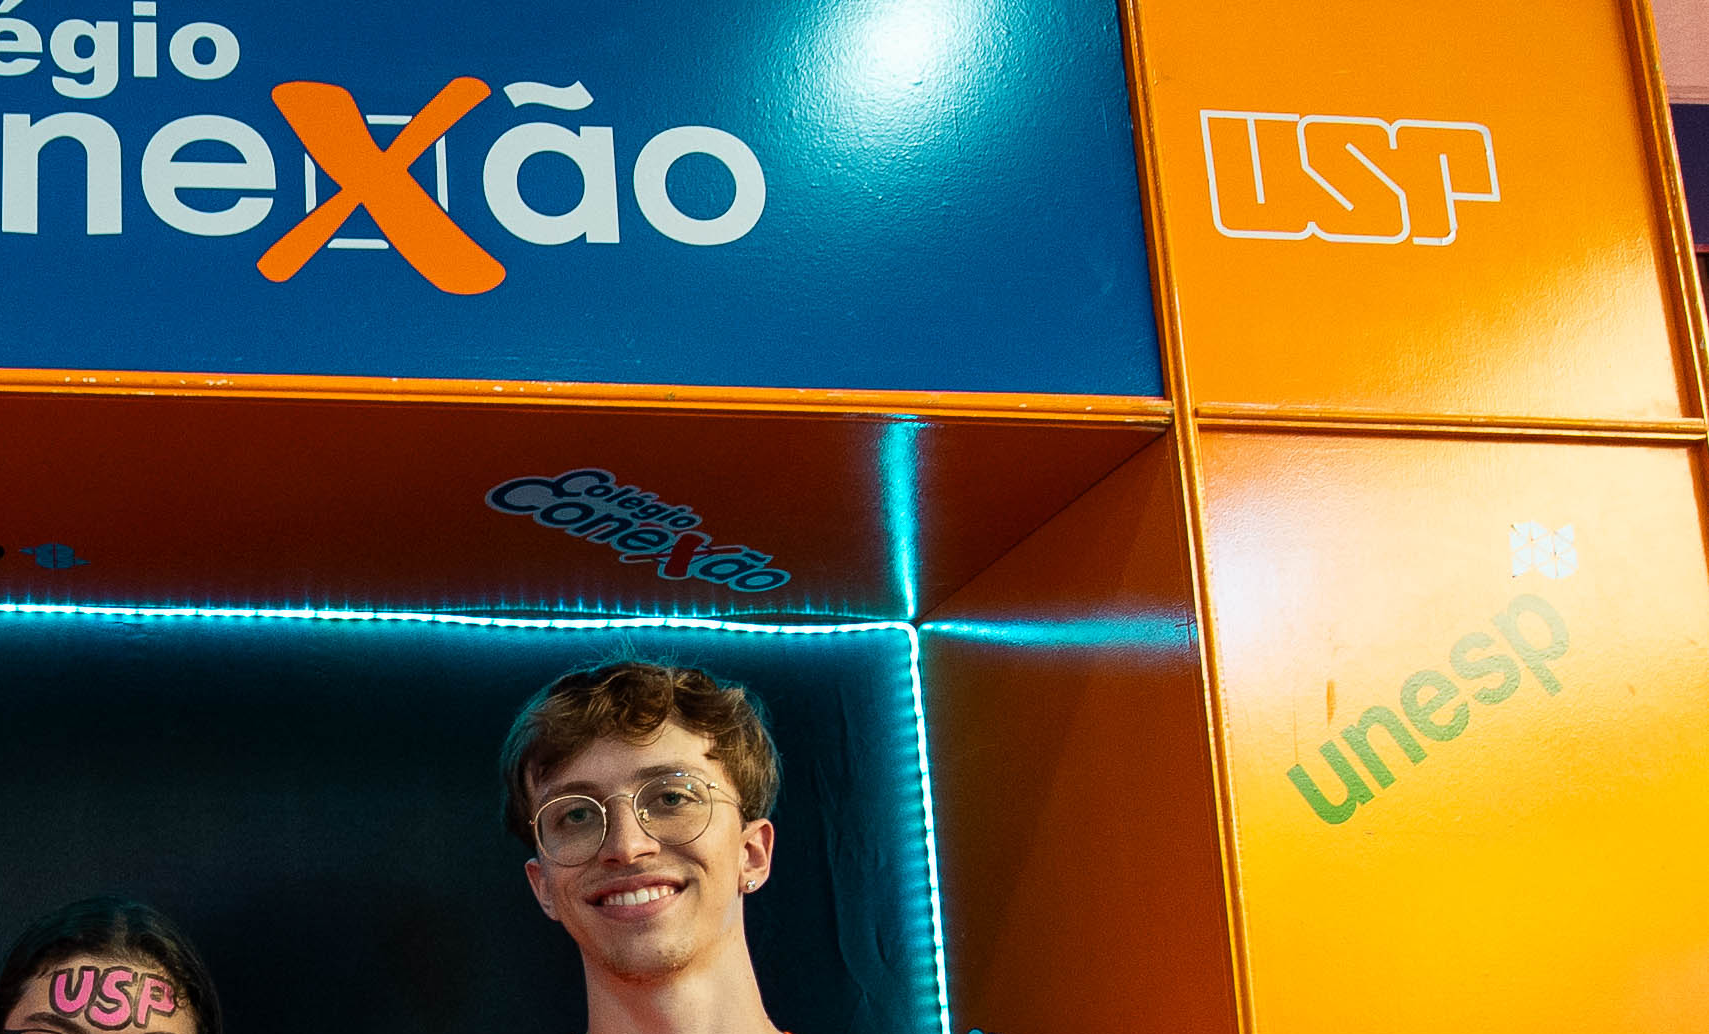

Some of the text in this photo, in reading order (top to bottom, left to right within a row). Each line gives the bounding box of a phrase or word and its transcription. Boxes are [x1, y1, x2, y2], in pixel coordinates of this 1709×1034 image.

[1199, 109, 1500, 246] USP
[554, 469, 696, 530] Colégio
[1287, 593, 1570, 825] unesp
[49, 966, 177, 1031] USP
